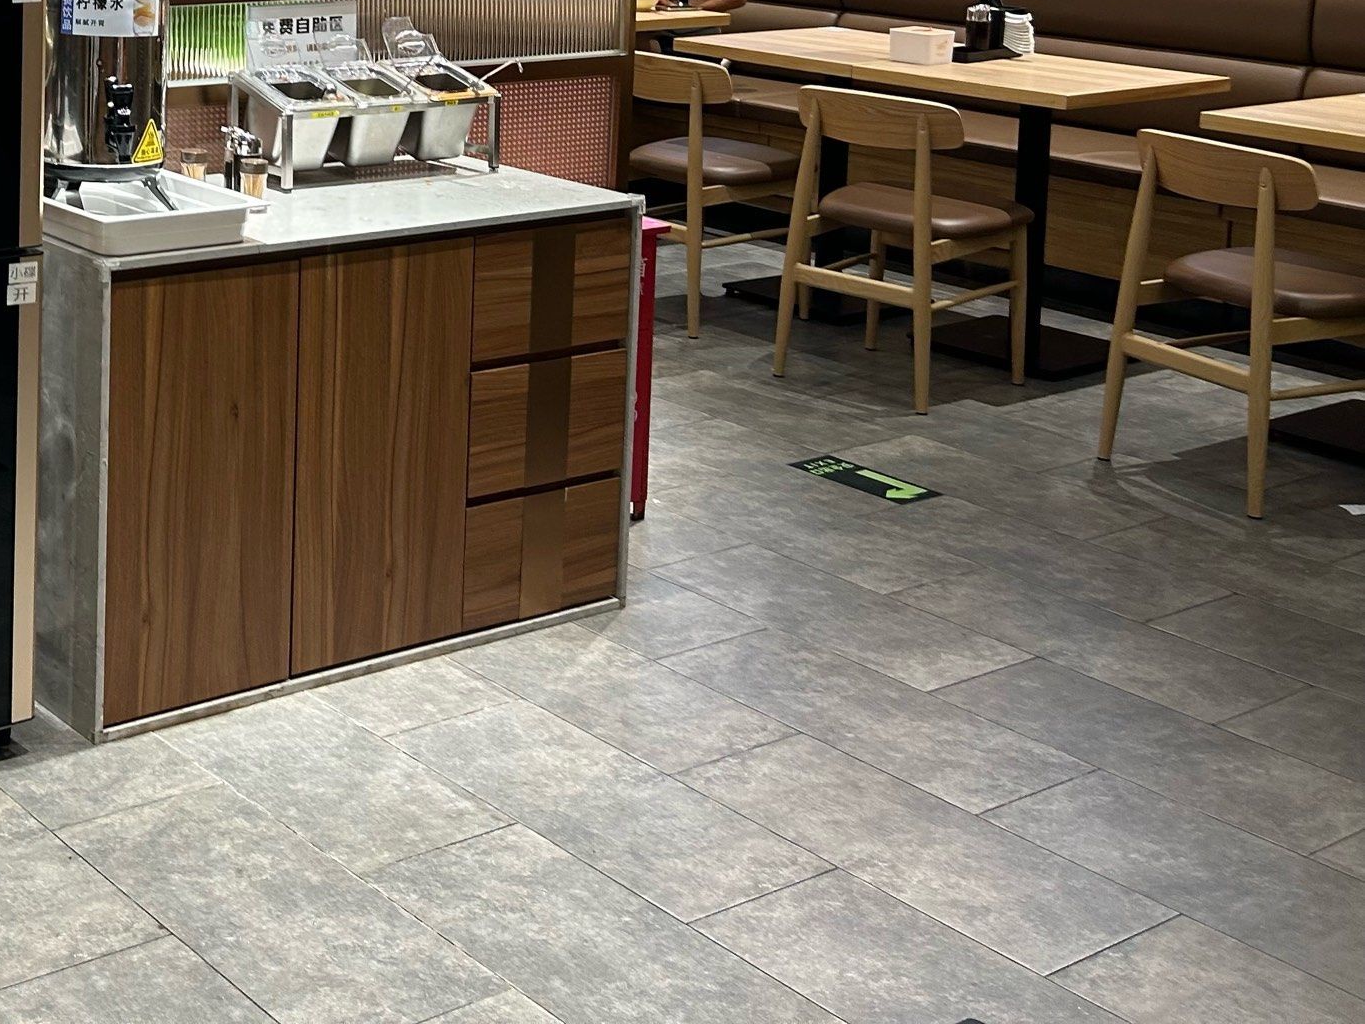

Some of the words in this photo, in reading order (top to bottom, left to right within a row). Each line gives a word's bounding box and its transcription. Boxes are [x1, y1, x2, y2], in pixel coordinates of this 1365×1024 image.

[262, 15, 343, 35] 免费自助区
[13, 287, 29, 302] 开
